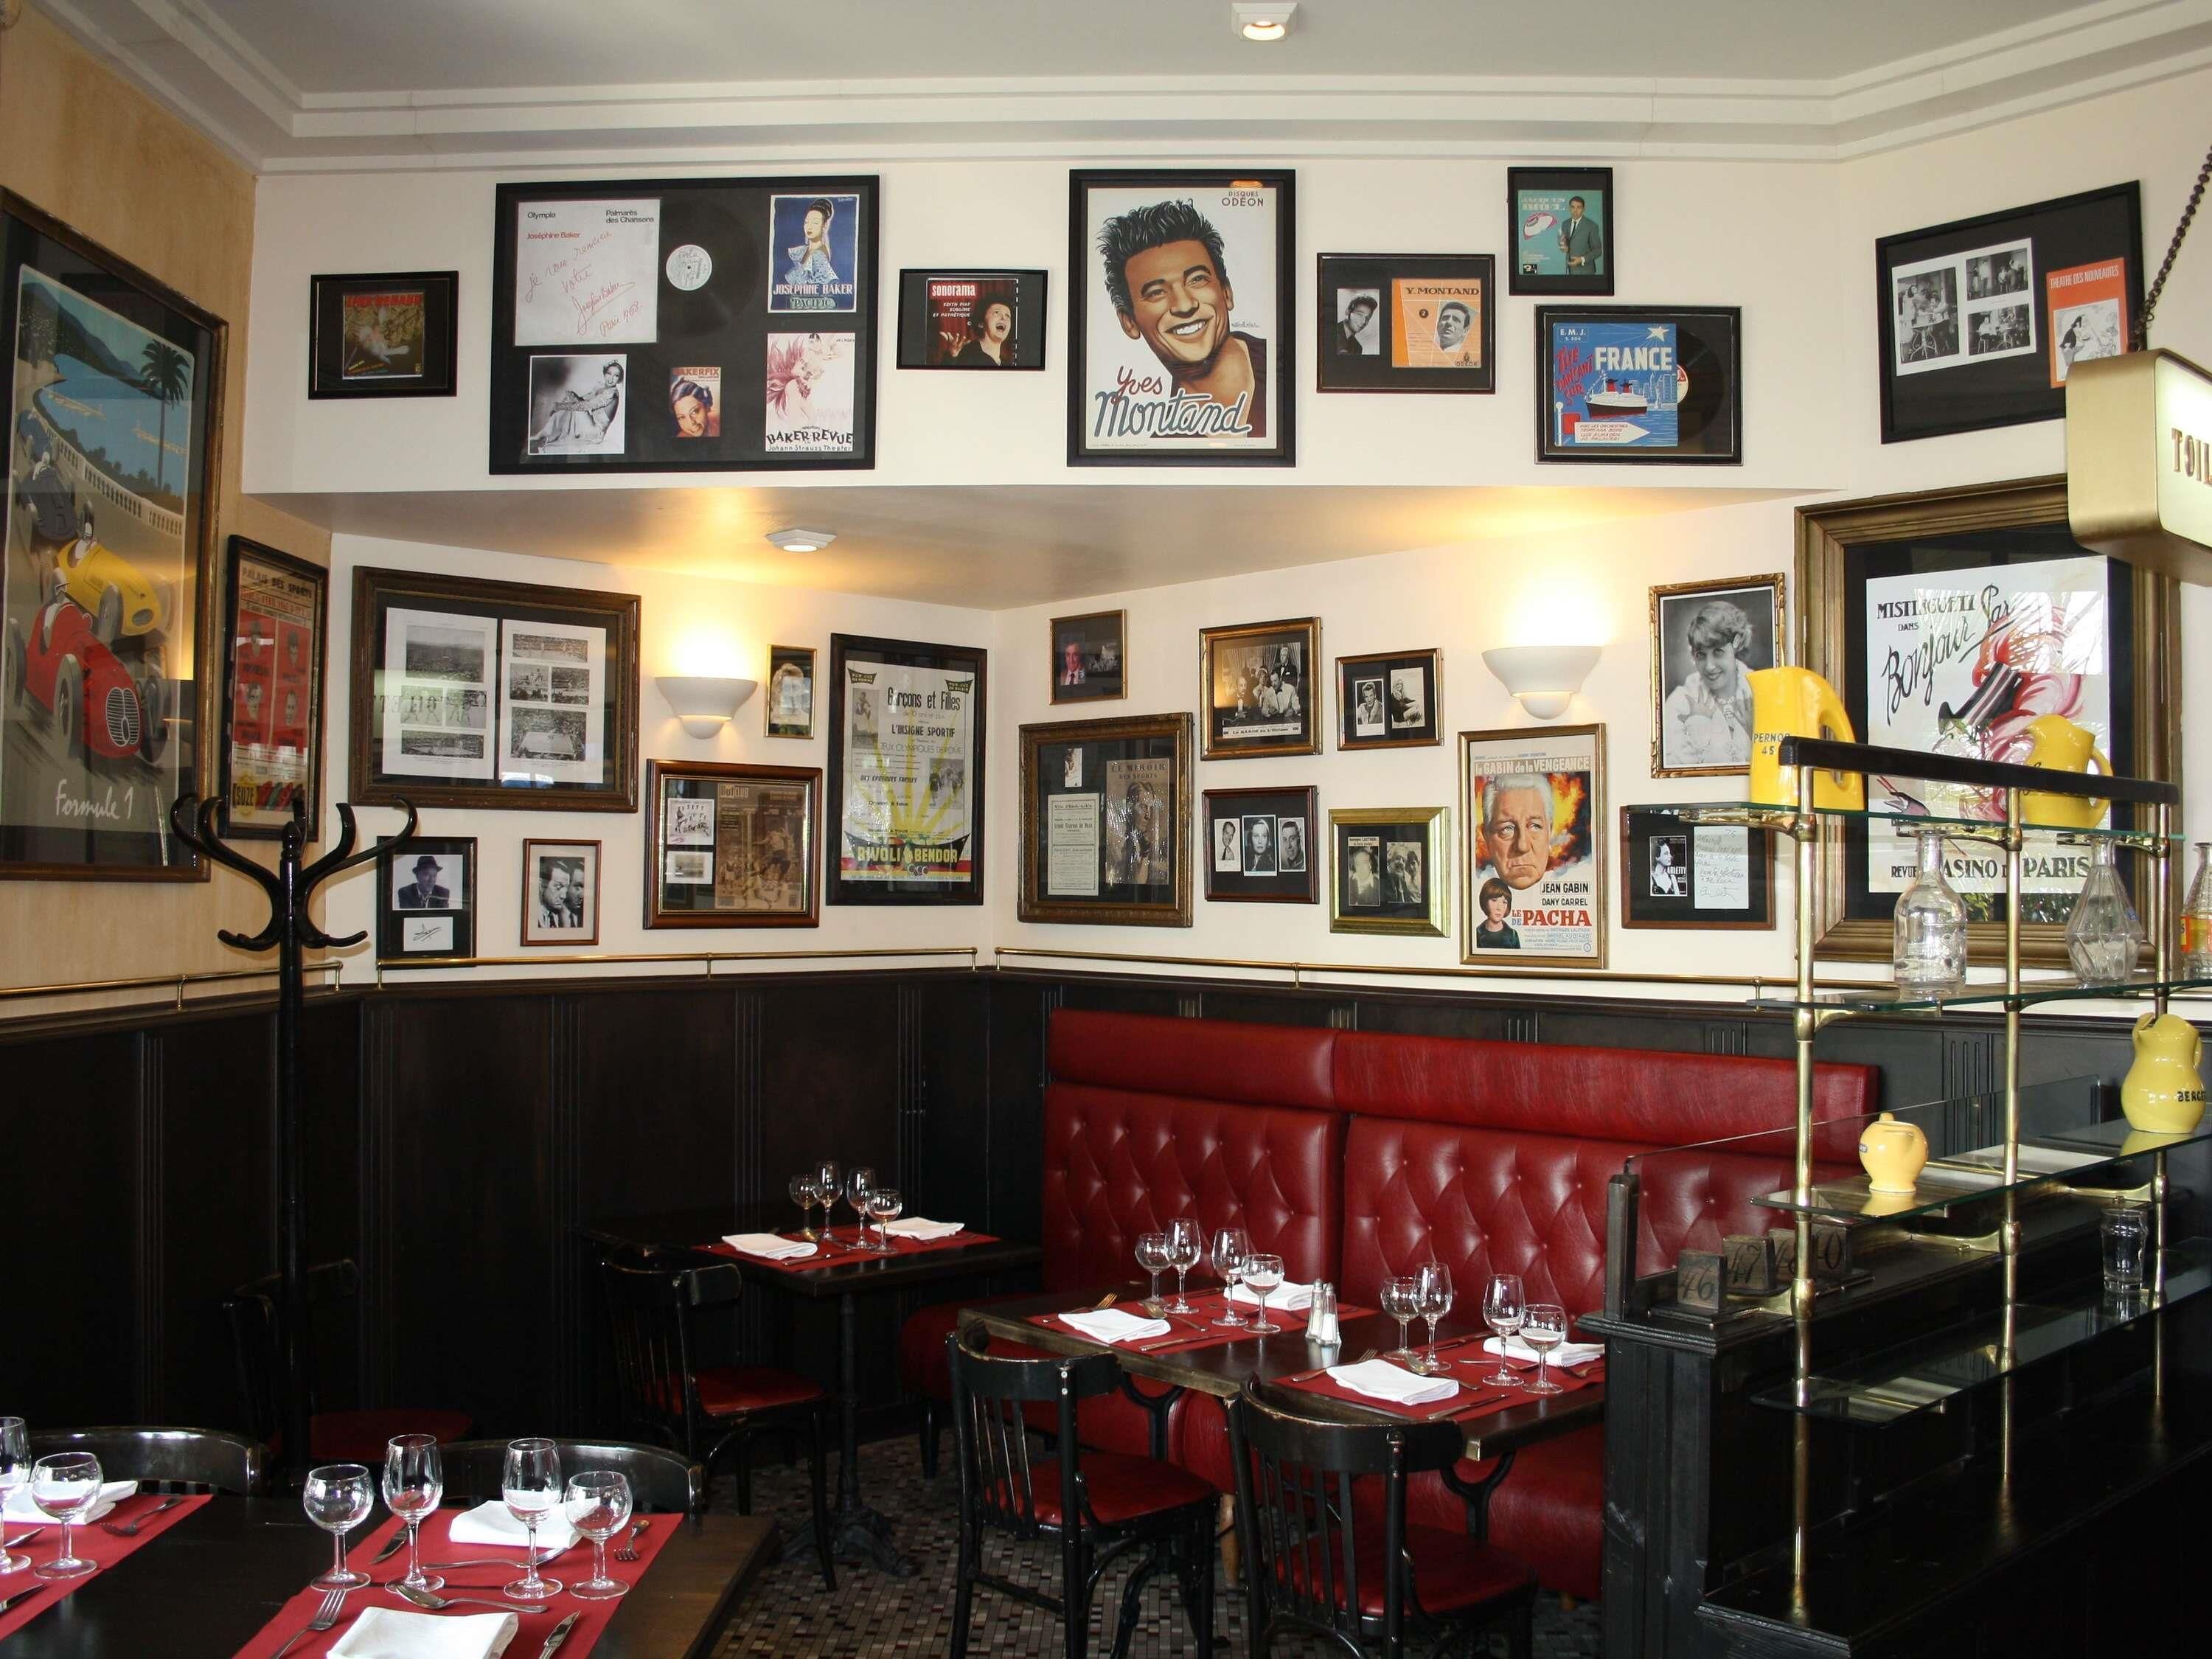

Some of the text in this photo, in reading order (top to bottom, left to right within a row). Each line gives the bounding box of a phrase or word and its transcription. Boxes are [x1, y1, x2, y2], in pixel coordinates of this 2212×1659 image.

[773, 283, 853, 295] JOSEPHINE BAKER
[931, 284, 976, 296] sonorama
[1595, 347, 1672, 371] FRANCE
[1111, 365, 1163, 405] Yves
[1093, 388, 1251, 439] Montand
[1898, 622, 1919, 632] DANS
[928, 690, 936, 709] et
[940, 691, 961, 711] Filles
[891, 724, 956, 738] L'INSIGNE SPORTIF
[1753, 732, 1790, 743] PERNO
[1761, 745, 1775, 755] 45
[1484, 761, 1514, 774] GABIN
[1515, 762, 1525, 773] de
[1526, 762, 1533, 773] la
[1534, 757, 1590, 772] VENGEANCE
[56, 779, 133, 820] Formule 1
[237, 785, 254, 807] SUZE
[914, 848, 959, 863] BENDOR
[1943, 858, 1998, 879] ASINO
[2023, 856, 2090, 878] PARIS
[1541, 883, 1588, 894] JEAN GABIN
[1542, 898, 1588, 906] DANY CARREL
[1512, 909, 1593, 927] LE PACHA
